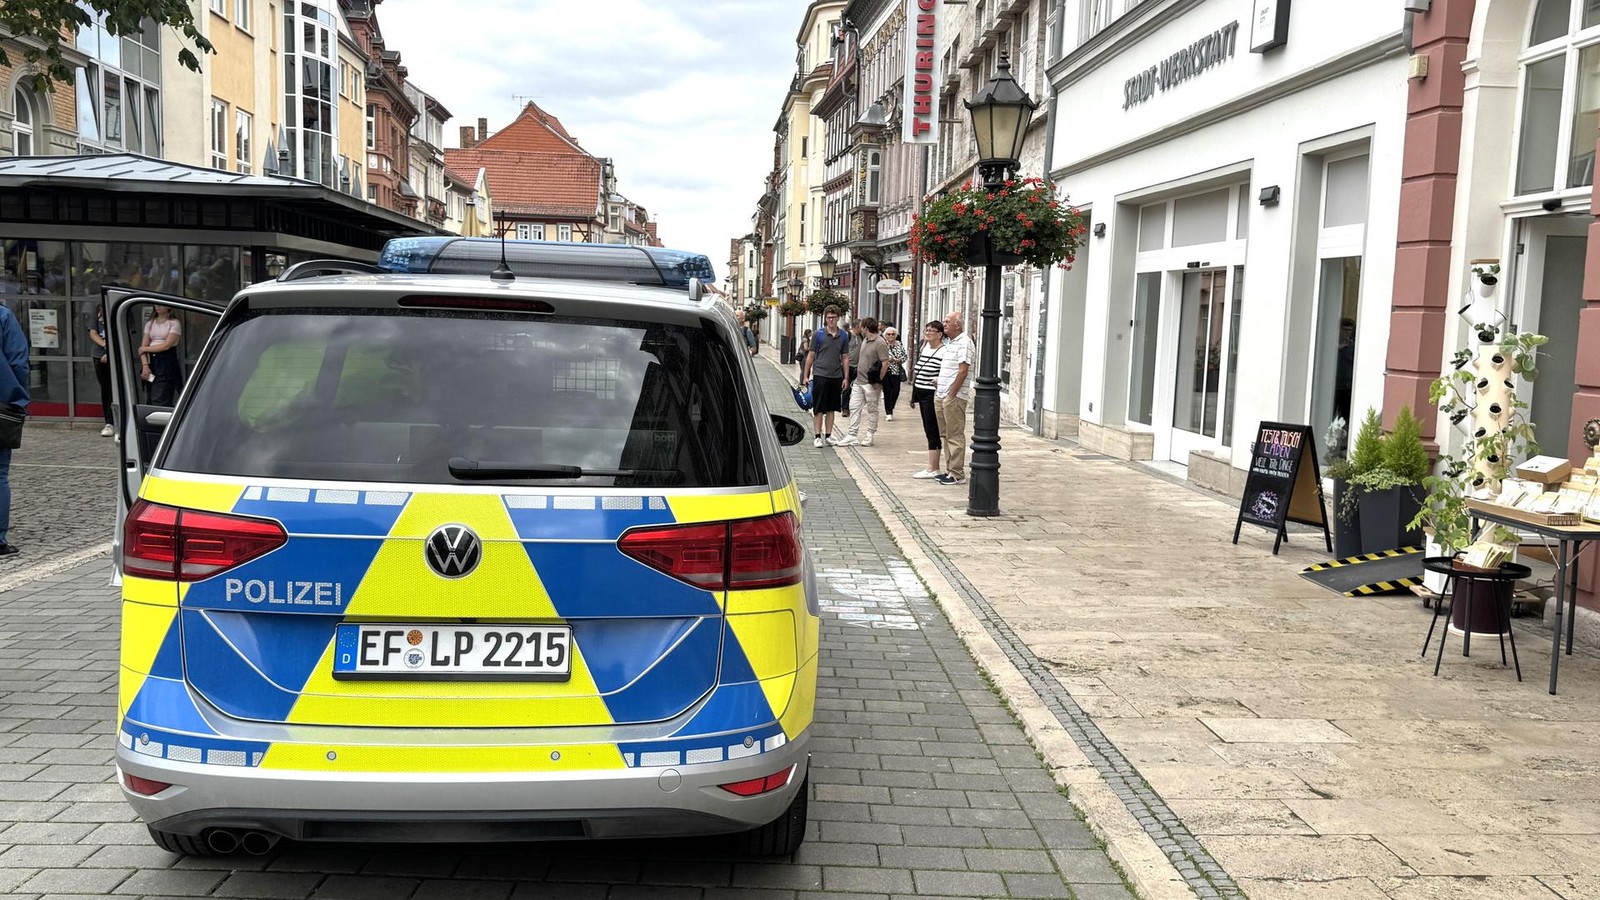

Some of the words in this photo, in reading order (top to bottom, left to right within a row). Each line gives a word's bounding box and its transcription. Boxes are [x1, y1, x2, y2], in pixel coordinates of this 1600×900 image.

[1122, 20, 1239, 110] STADT-WERKSTATT
[1263, 443, 1290, 458] LADEN
[225, 578, 341, 606] POLIZEI
[342, 653, 350, 664] D
[360, 630, 404, 666] EF
[431, 631, 474, 667] LP
[482, 632, 566, 667] 2215
